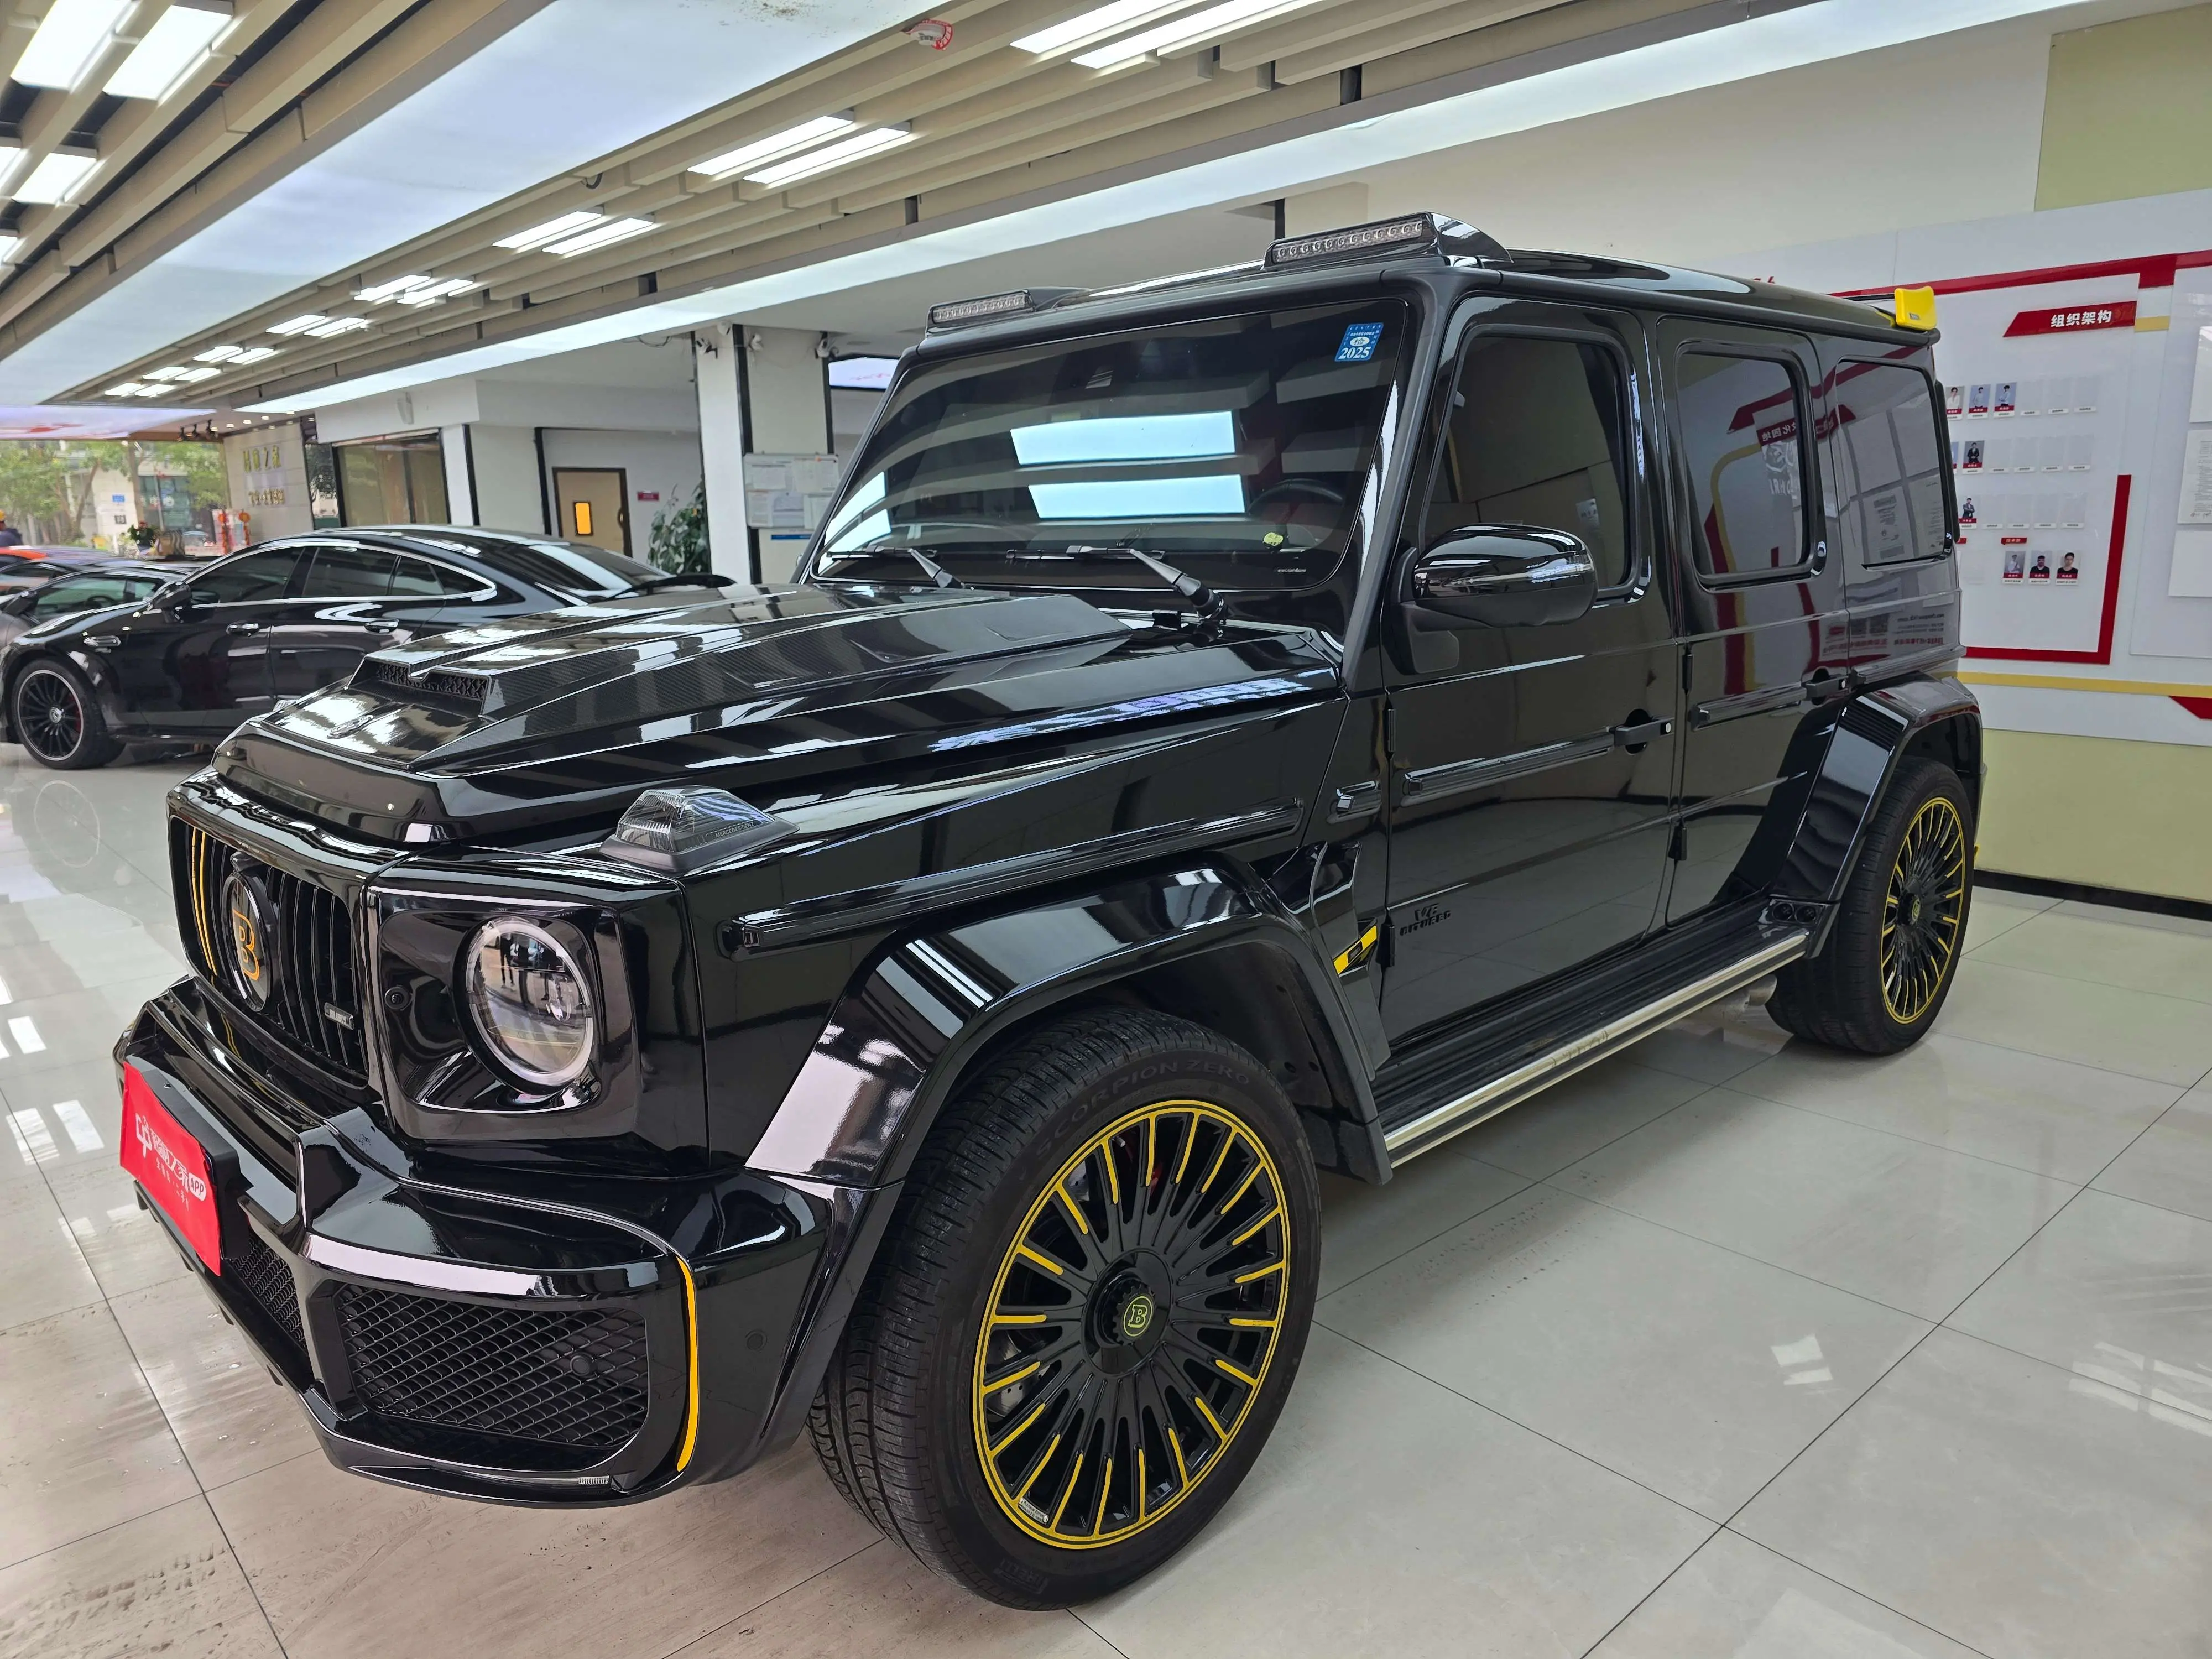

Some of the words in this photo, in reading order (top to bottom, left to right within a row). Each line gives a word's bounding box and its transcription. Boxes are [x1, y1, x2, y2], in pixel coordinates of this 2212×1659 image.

[2051, 310, 2112, 327] 组织架构
[1338, 346, 1372, 359] 2025
[715, 822, 754, 838] MERCEDES-BENZ
[1036, 1061, 1178, 1158] SCORPION
[1185, 1059, 1249, 1084] ZERO
[190, 1178, 204, 1196] APP
[1128, 1304, 1148, 1328] B
